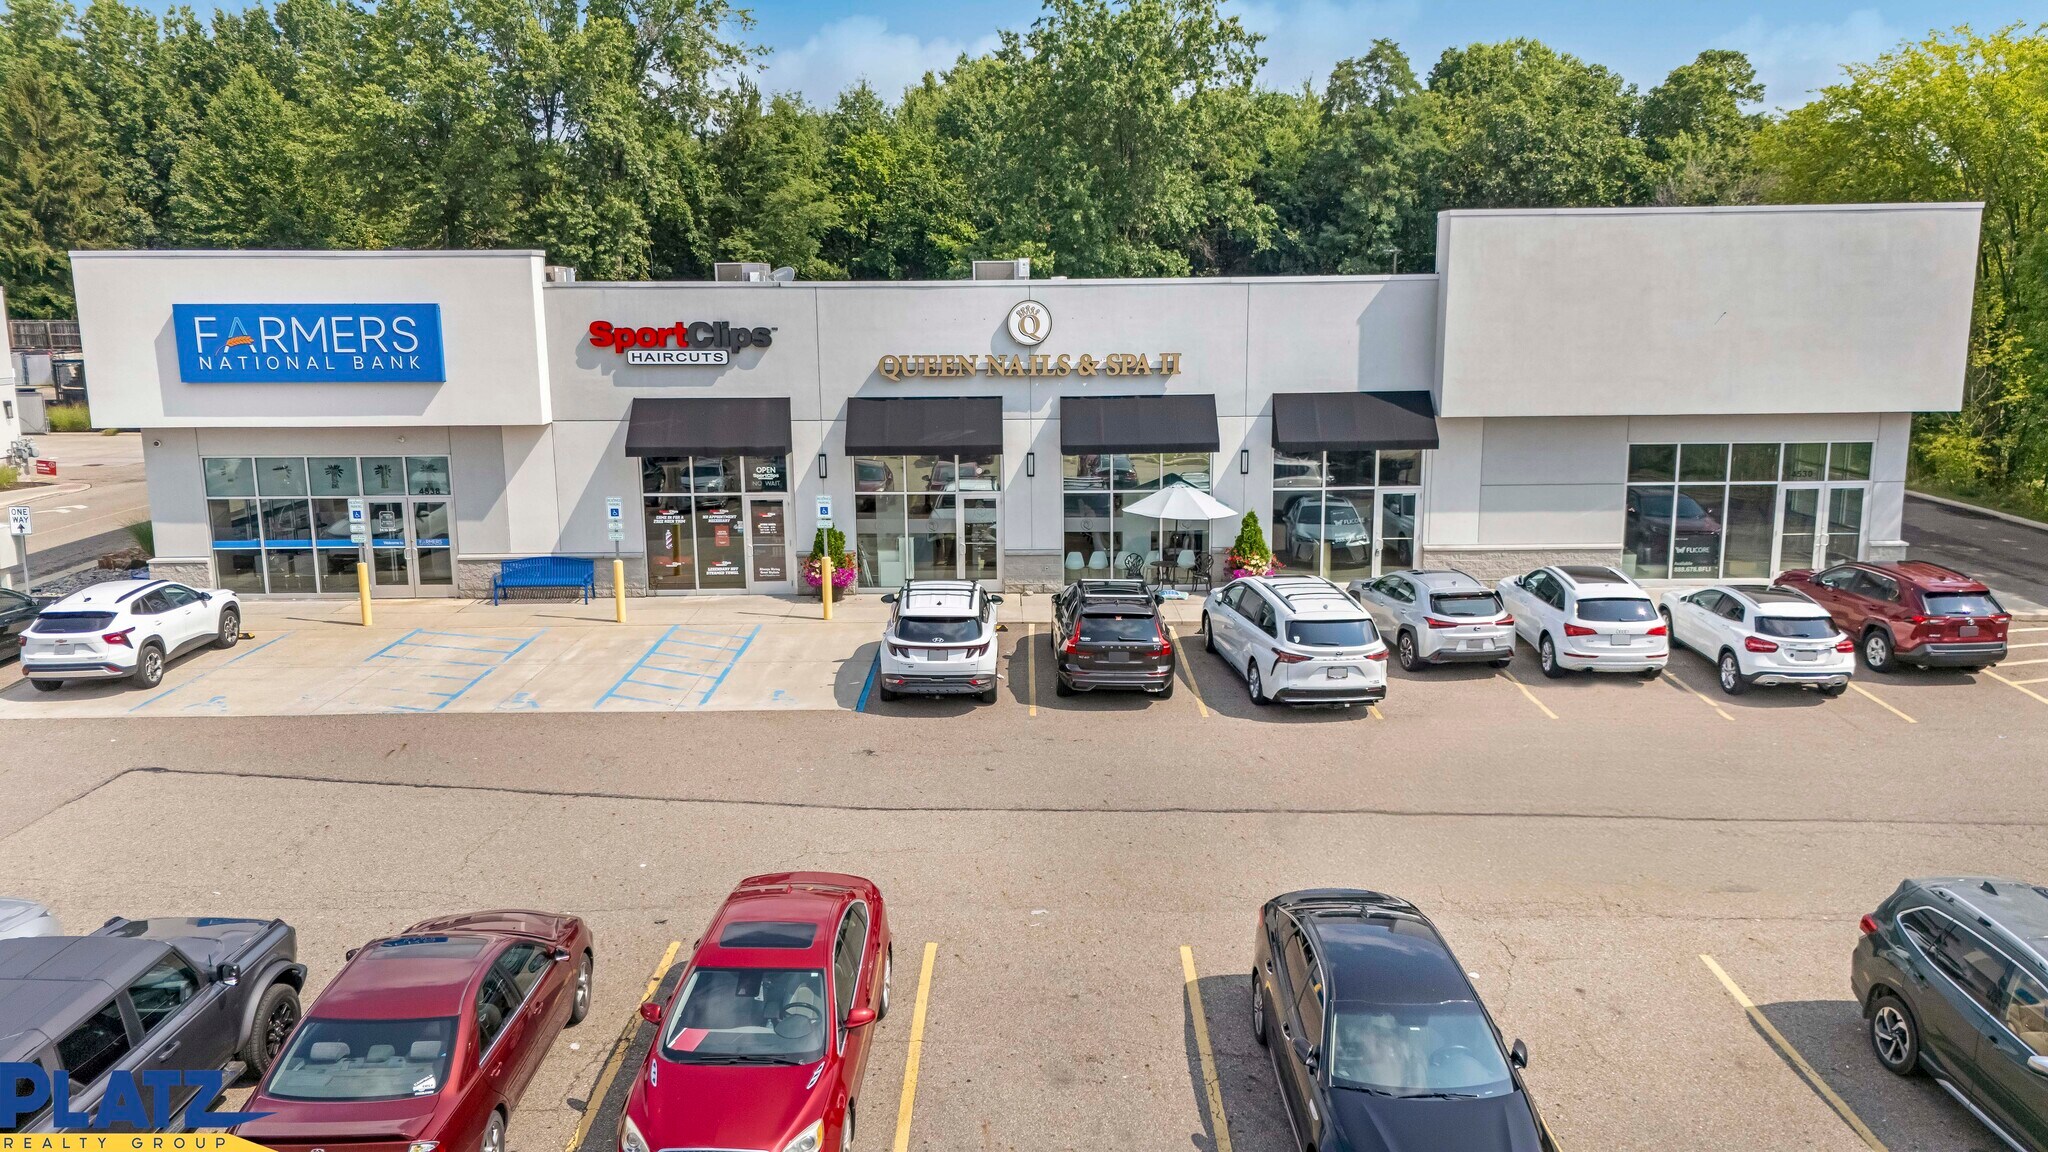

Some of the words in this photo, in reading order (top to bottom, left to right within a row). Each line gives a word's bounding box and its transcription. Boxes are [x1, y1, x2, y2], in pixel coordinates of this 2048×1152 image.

[1018, 315, 1042, 341] Q
[194, 317, 419, 354] FARMERS
[589, 320, 773, 354] SportClips
[199, 356, 336, 371] NATIONAL
[353, 355, 421, 371] BANK
[631, 352, 724, 363] HAIRCUTS
[878, 354, 978, 382] QUEEN
[984, 353, 1071, 377] NAILS
[1077, 353, 1100, 376] &
[1105, 352, 1153, 376] SPA
[1159, 352, 1181, 375] II
[755, 466, 776, 474] OPEN
[1791, 470, 1813, 478] 4530
[419, 487, 441, 495] 4538
[1686, 546, 1710, 554] FLICORE
